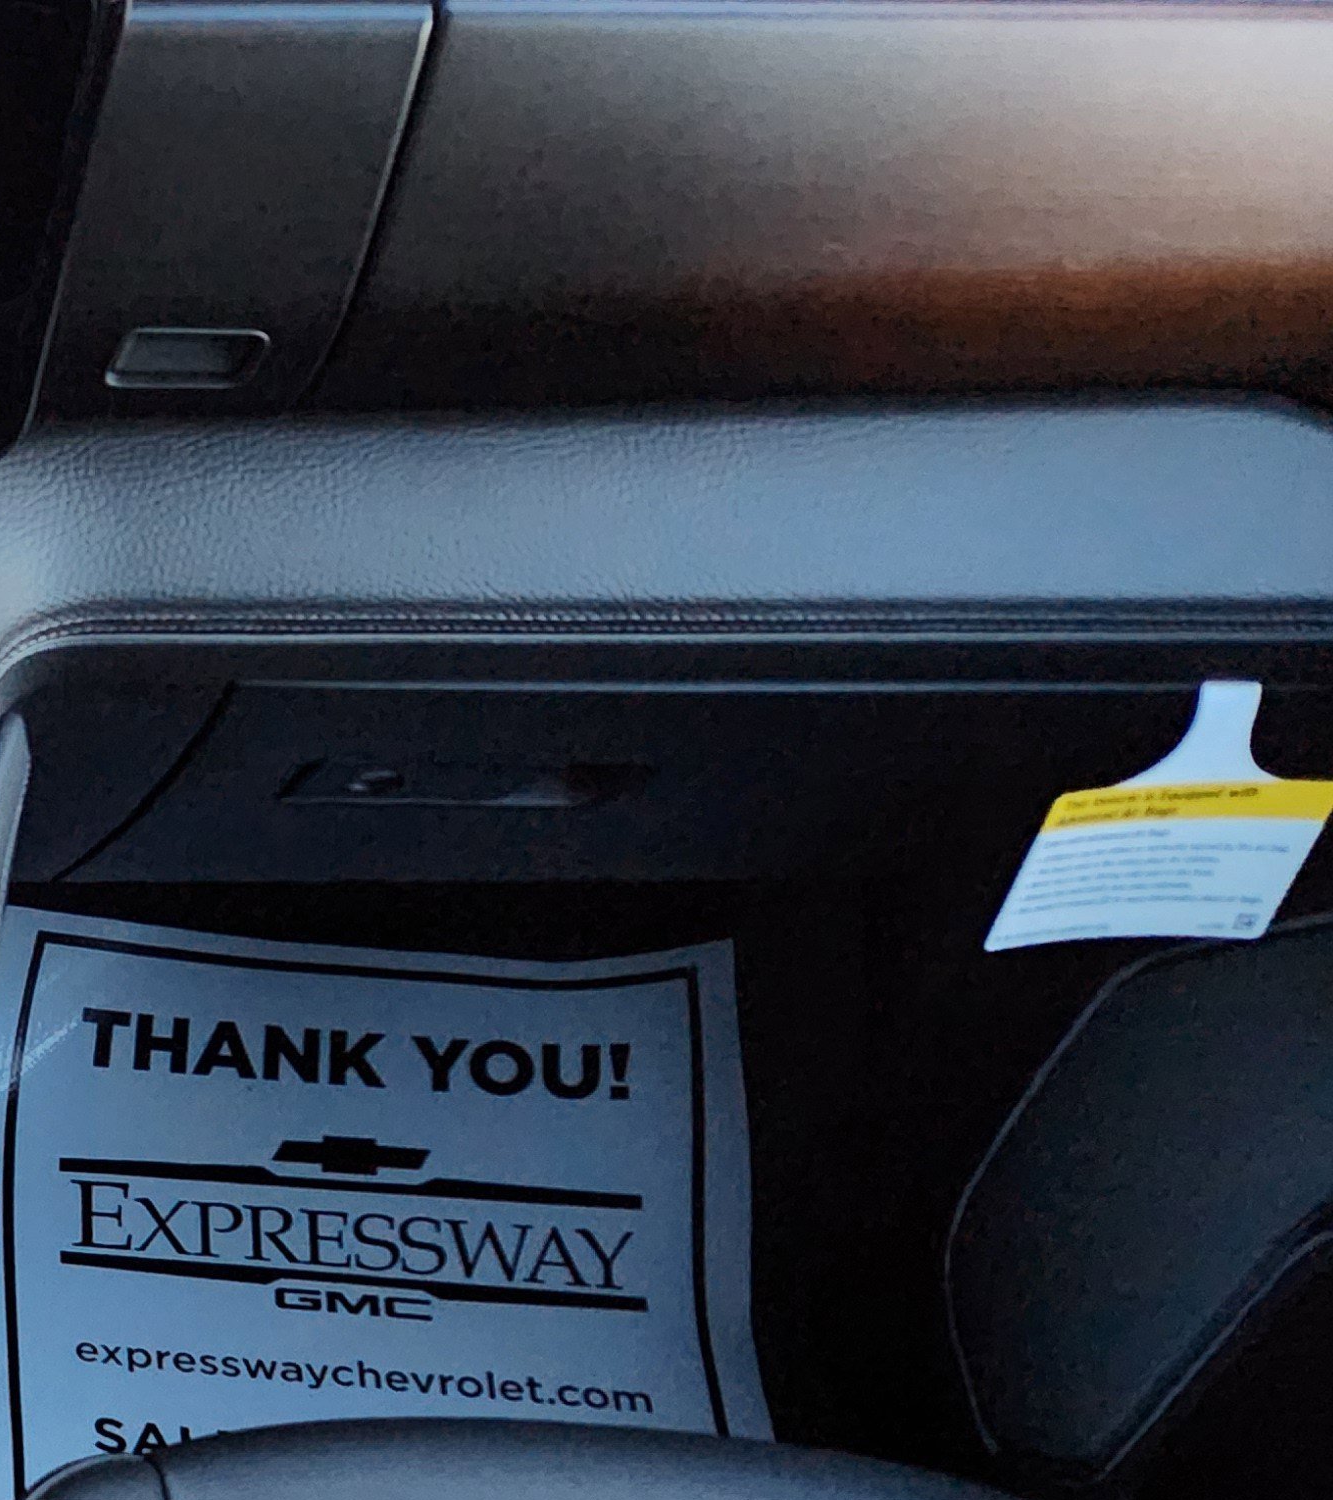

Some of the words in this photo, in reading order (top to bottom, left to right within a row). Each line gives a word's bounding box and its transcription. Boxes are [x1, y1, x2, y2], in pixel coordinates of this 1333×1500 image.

[82, 1006, 386, 1090] THANK
[413, 1035, 631, 1101] YOU!
[69, 1179, 633, 1291] EXPRESSWAY
[274, 1286, 434, 1321] GMC
[75, 1338, 654, 1415] expresswaychevrolet.com
